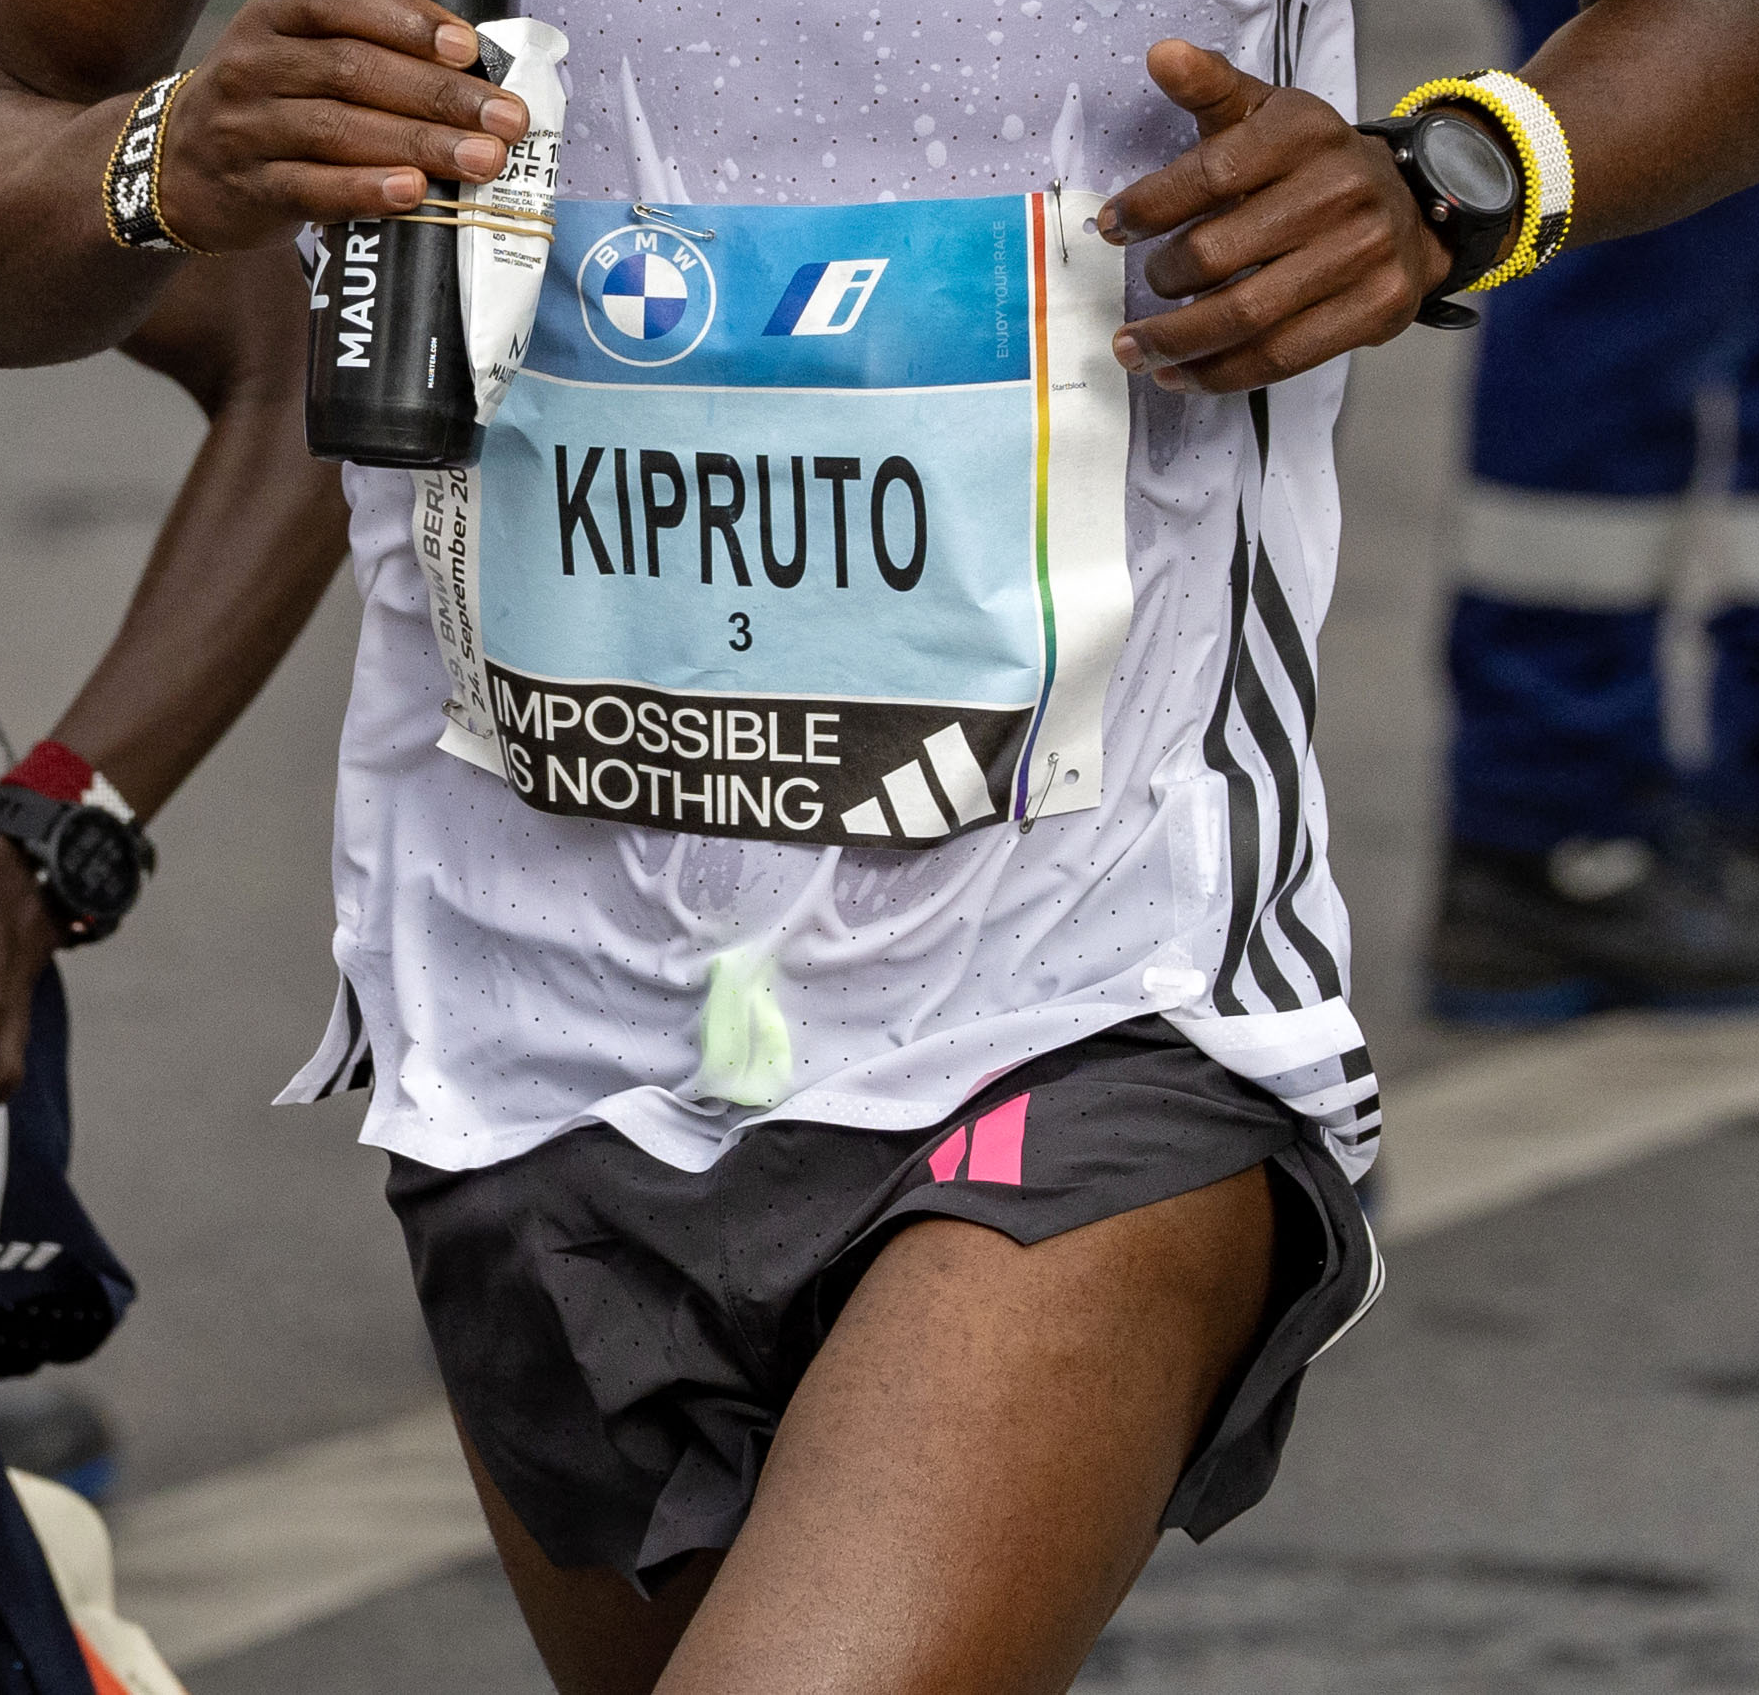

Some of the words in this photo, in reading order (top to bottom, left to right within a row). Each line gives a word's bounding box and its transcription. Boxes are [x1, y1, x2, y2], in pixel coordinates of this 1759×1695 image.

[507, 140, 540, 161] EL
[595, 232, 698, 271] BMW
[993, 220, 1006, 261] RACE
[994, 265, 1008, 308] YOUR
[995, 311, 1010, 360] ENJOY
[554, 444, 928, 592] KIPRUTO
[426, 562, 457, 647] BMW
[447, 505, 479, 664] September
[727, 611, 753, 652] 3
[469, 672, 487, 713] 24.
[493, 675, 842, 765] IMPOSSIBLE
[502, 735, 535, 794] IS
[546, 754, 825, 832] NOTHING
